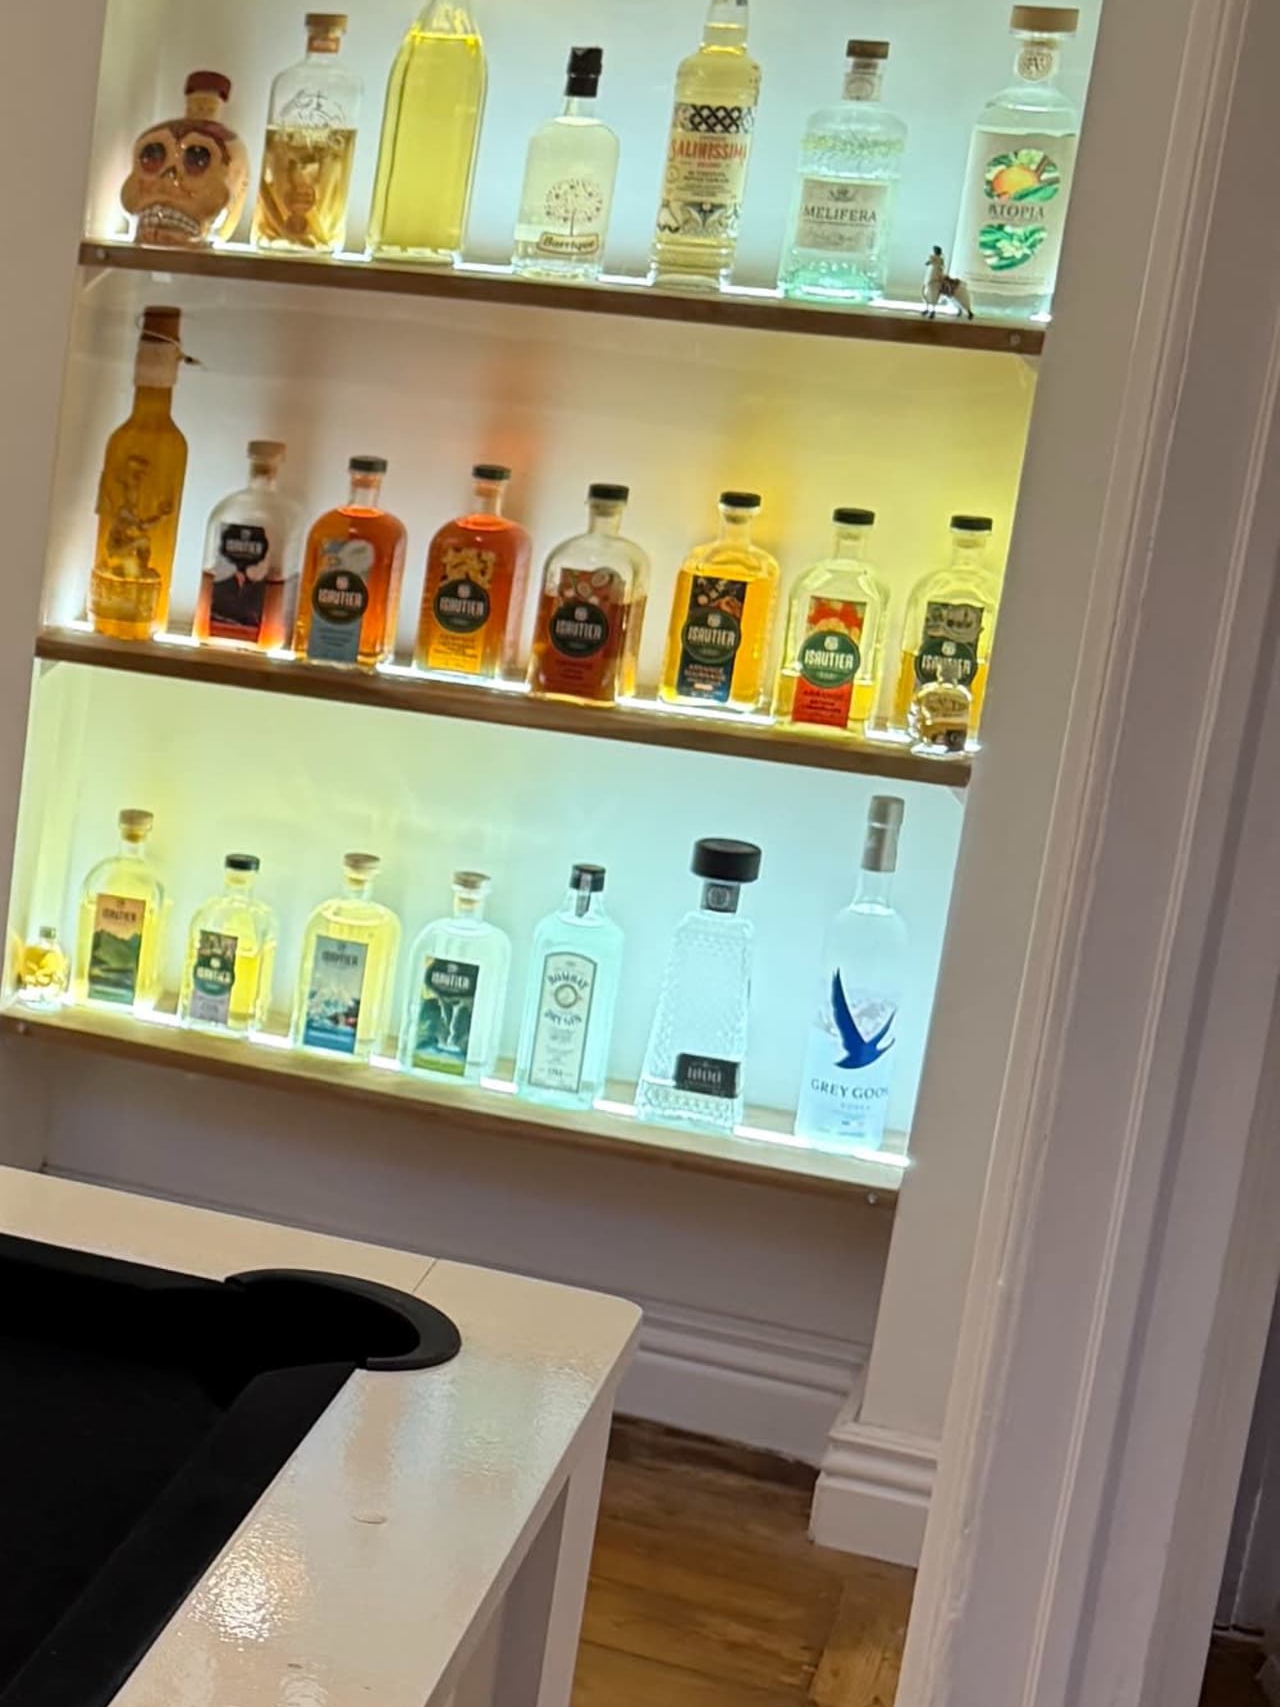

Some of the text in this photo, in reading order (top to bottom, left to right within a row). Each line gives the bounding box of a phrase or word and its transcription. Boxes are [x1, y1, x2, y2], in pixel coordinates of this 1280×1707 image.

[803, 205, 877, 223] MELIFERA
[687, 627, 737, 647] ISAUTIER
[804, 649, 854, 671] ISAUTIER
[810, 1077, 849, 1099] GREY
